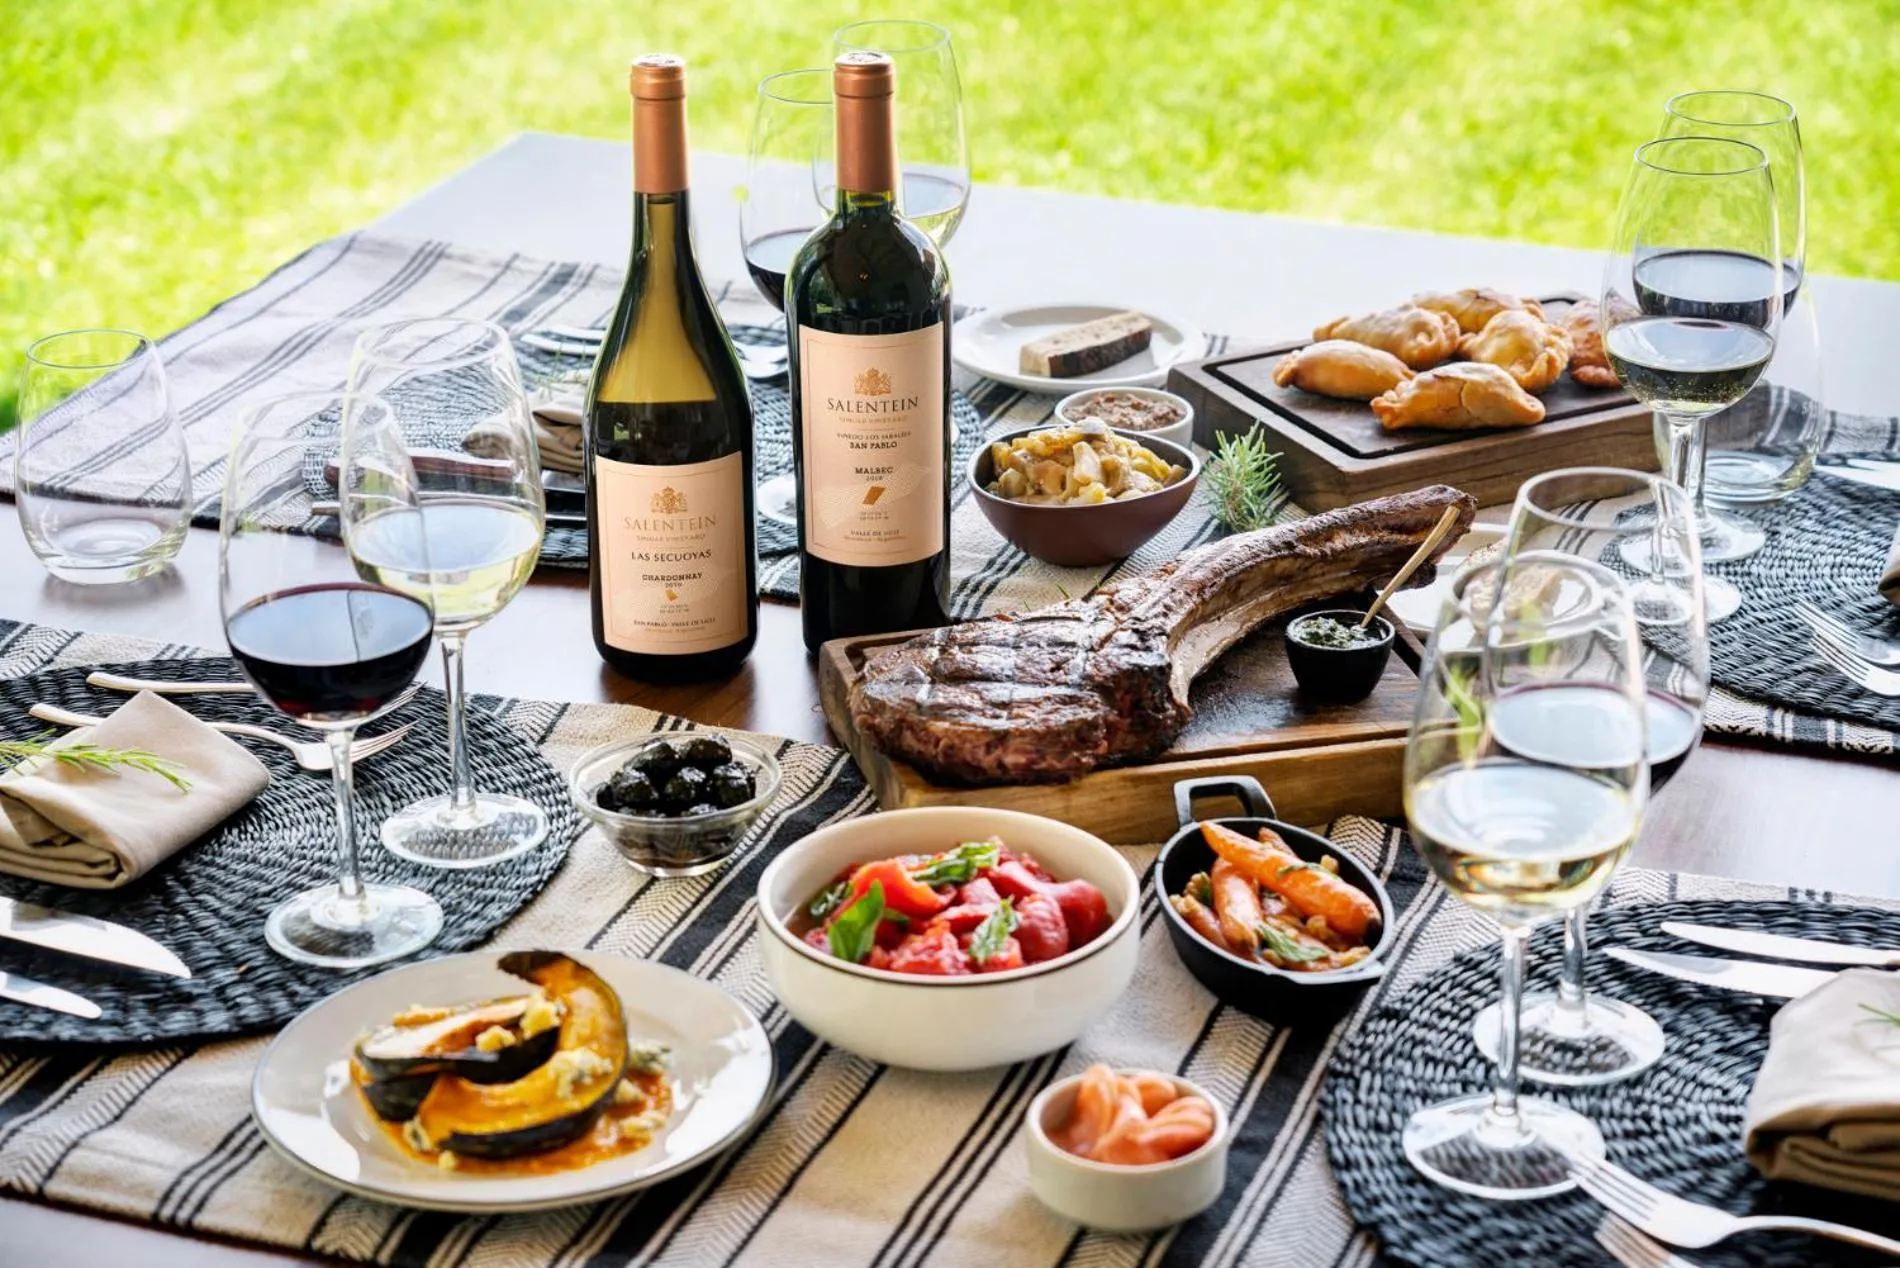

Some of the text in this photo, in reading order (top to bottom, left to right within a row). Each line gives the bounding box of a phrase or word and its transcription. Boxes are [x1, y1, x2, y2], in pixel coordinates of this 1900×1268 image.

[827, 396, 918, 413] SALENTEIN
[849, 441, 898, 450] SAN PABLO
[855, 466, 894, 475] MALBEC
[624, 515, 716, 530] SALENTEIN
[631, 548, 712, 562] LAS SECUOYAS
[642, 572, 703, 582] CHARDONNAY
